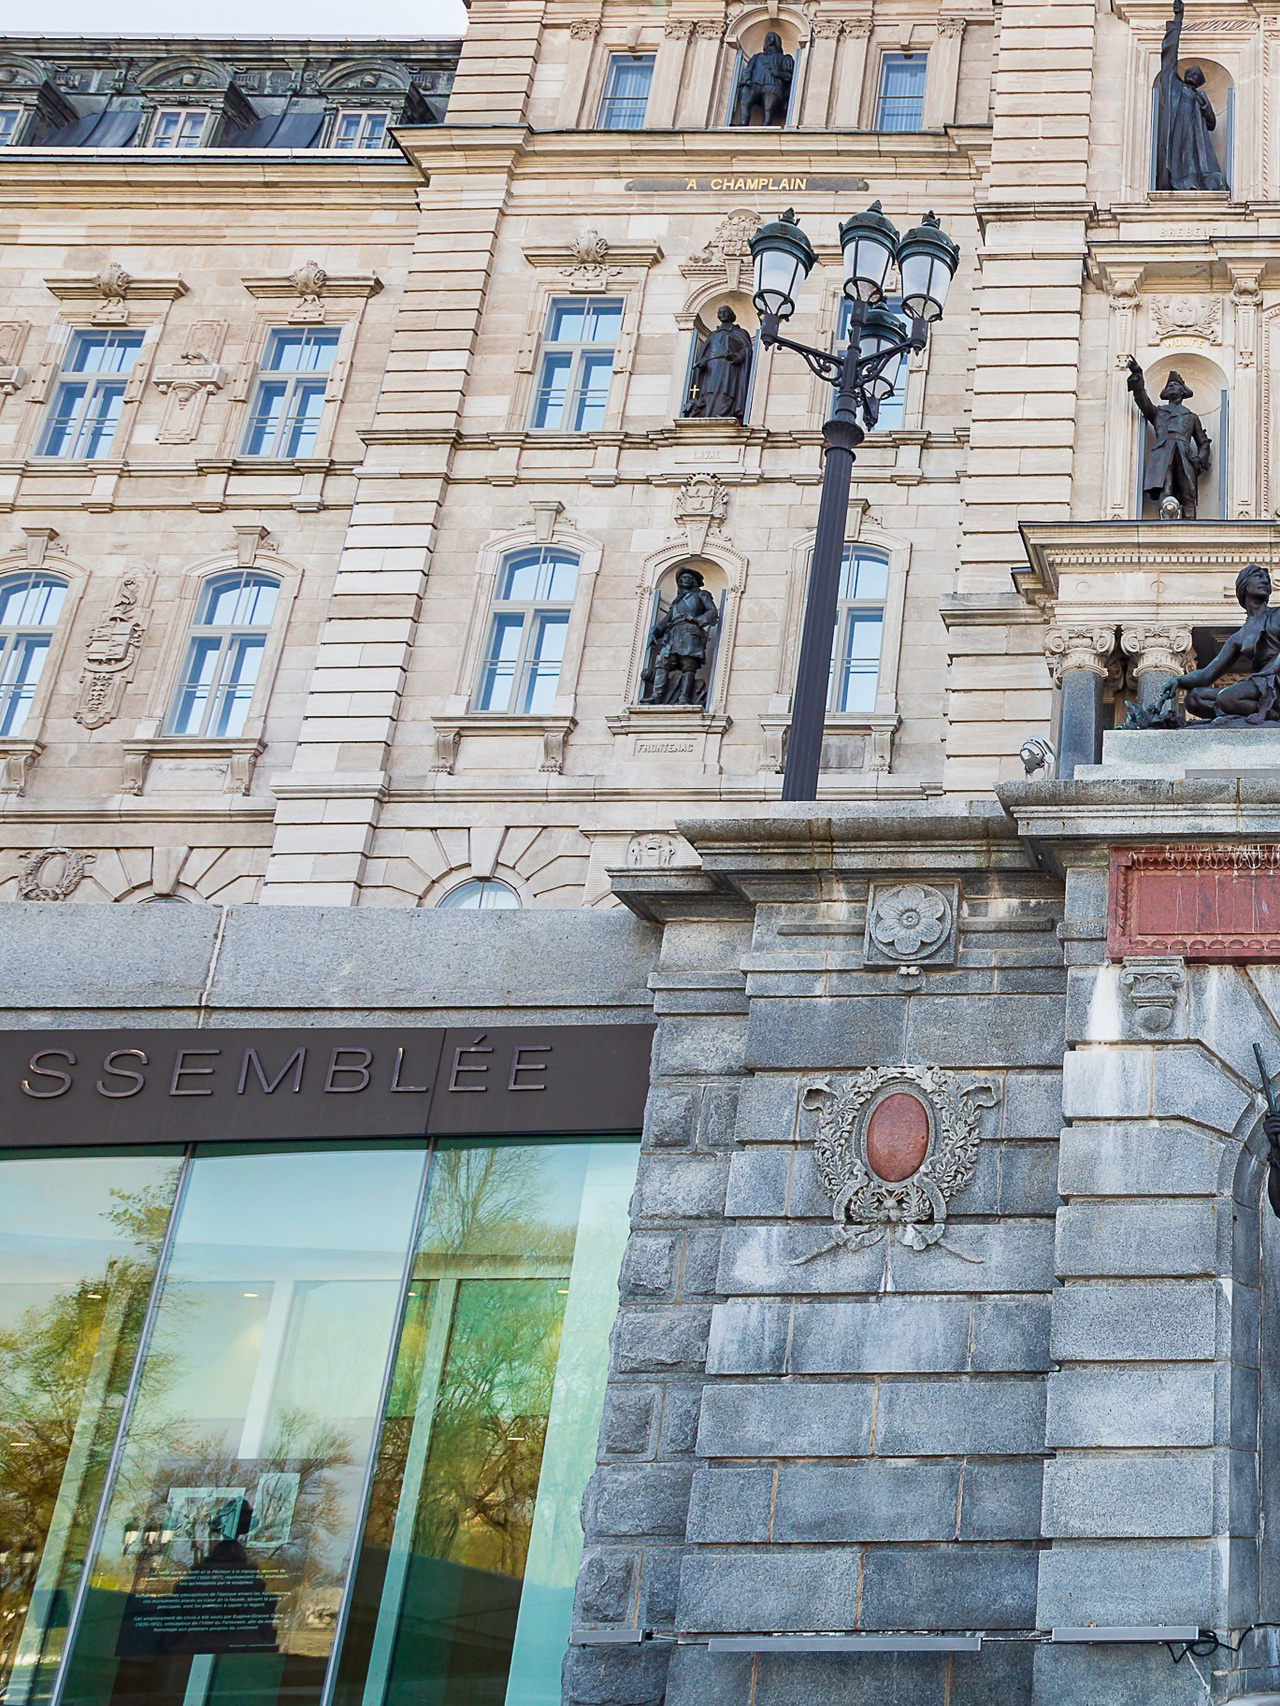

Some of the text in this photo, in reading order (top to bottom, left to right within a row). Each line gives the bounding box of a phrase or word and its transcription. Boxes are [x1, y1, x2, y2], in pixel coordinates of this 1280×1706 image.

[710, 178, 808, 191] CHAMPLAIN
[1162, 336, 1206, 349] WOLFE
[637, 743, 695, 753] FRONTENAC
